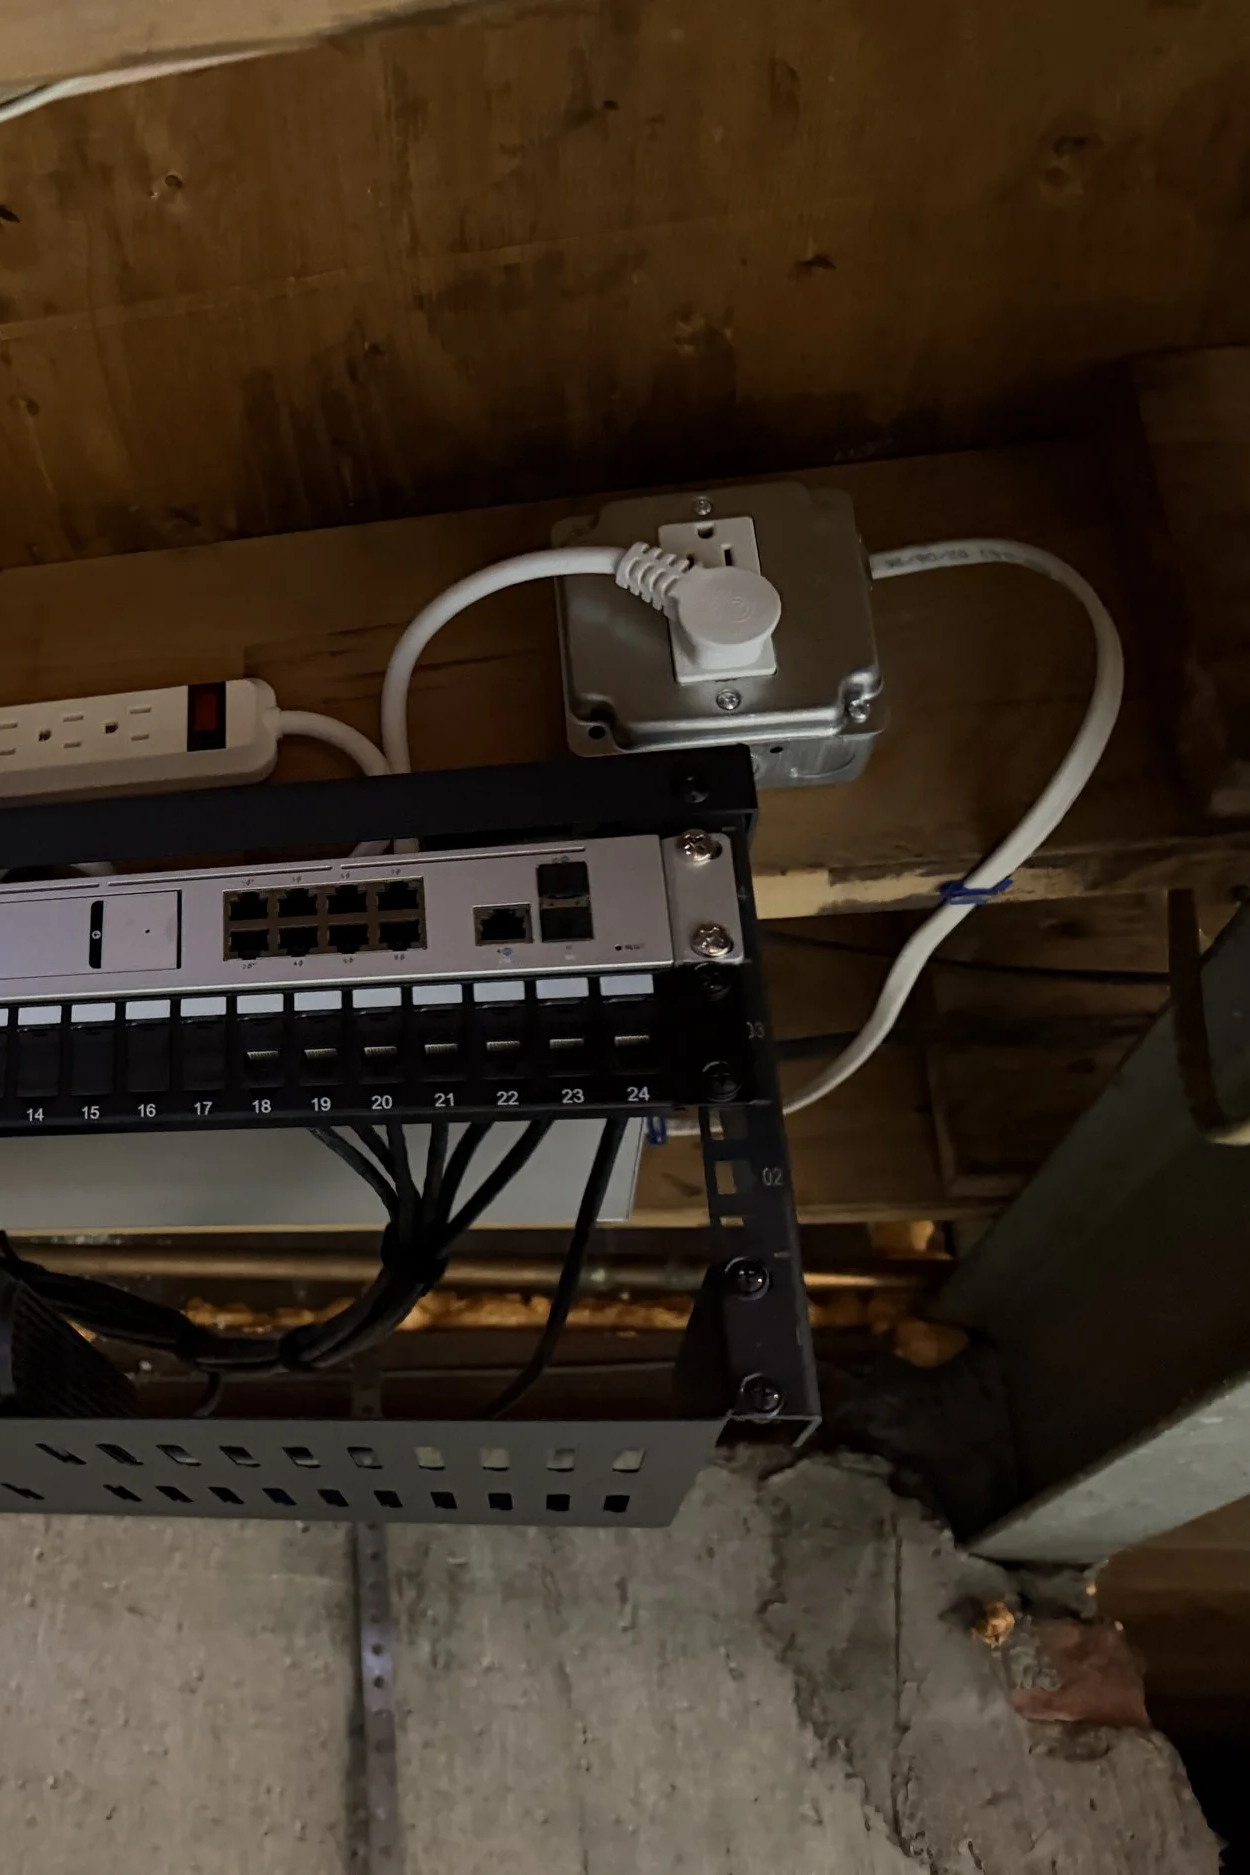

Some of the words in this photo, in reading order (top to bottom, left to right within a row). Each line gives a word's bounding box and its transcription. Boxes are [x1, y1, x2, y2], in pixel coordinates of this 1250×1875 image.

[26, 1107, 45, 1122] 14
[81, 1105, 100, 1120] 15
[137, 1103, 156, 1118] 16
[194, 1101, 213, 1116] 17
[252, 1099, 272, 1114] 18
[311, 1096, 331, 1112] 19
[371, 1094, 393, 1110] 20
[434, 1092, 454, 1107] 21
[496, 1090, 519, 1106] 22
[561, 1088, 584, 1104] 23
[627, 1086, 650, 1102] 24
[762, 1168, 783, 1186] 02
